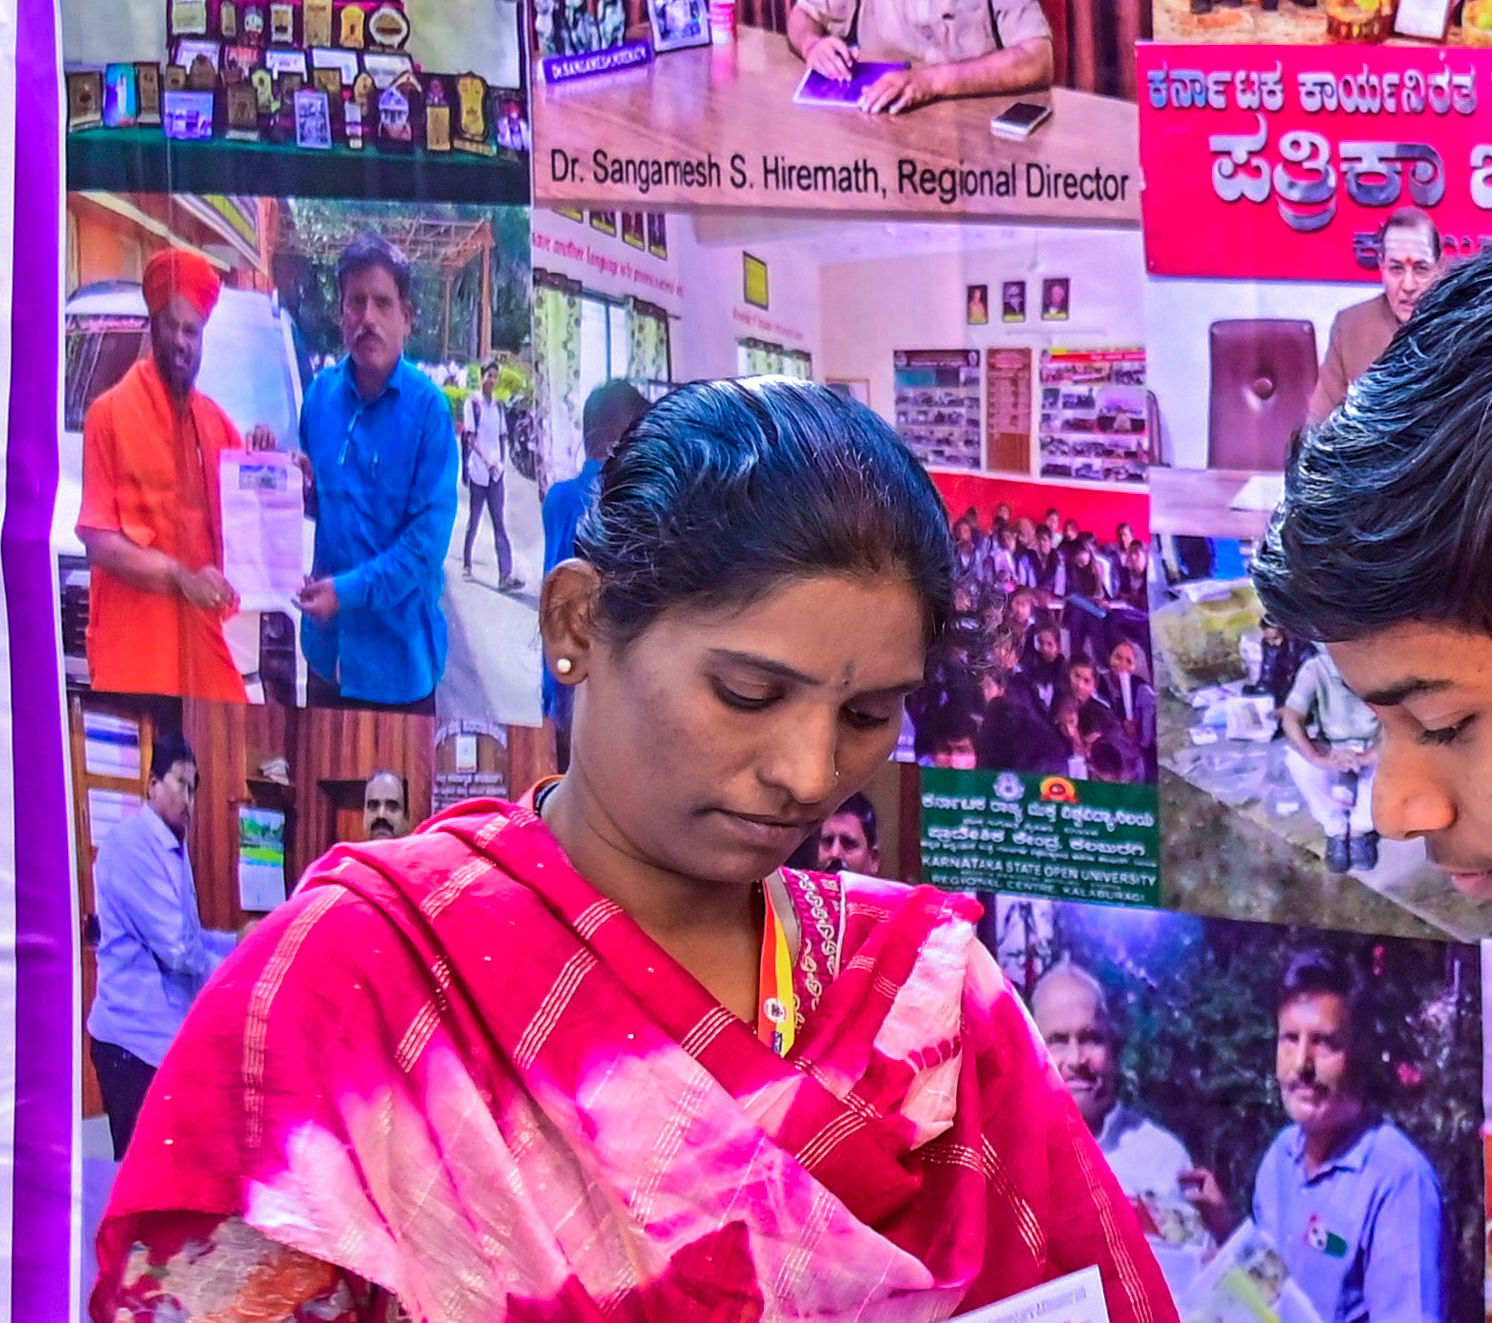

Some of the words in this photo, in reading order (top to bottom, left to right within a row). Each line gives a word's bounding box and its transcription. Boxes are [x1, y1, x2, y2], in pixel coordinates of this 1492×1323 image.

[1147, 61, 1284, 112] ಕರ್ನಾಟಕ
[1298, 52, 1477, 116] ಕಾರ್ಯನಿರತ
[551, 149, 584, 183] Dr.
[593, 151, 720, 194] Sangamesh
[730, 154, 756, 189] S.
[763, 155, 887, 199] Hiremath,
[899, 159, 1016, 206] Regional
[1026, 163, 1129, 201] Director
[1208, 113, 1446, 231] ಪತ್ರಿಕಾ
[922, 855, 1001, 871] KARNATAKA
[1006, 861, 1041, 875] STATE
[1044, 866, 1079, 880] OPEN
[1081, 870, 1156, 886] UNIVERSITY
